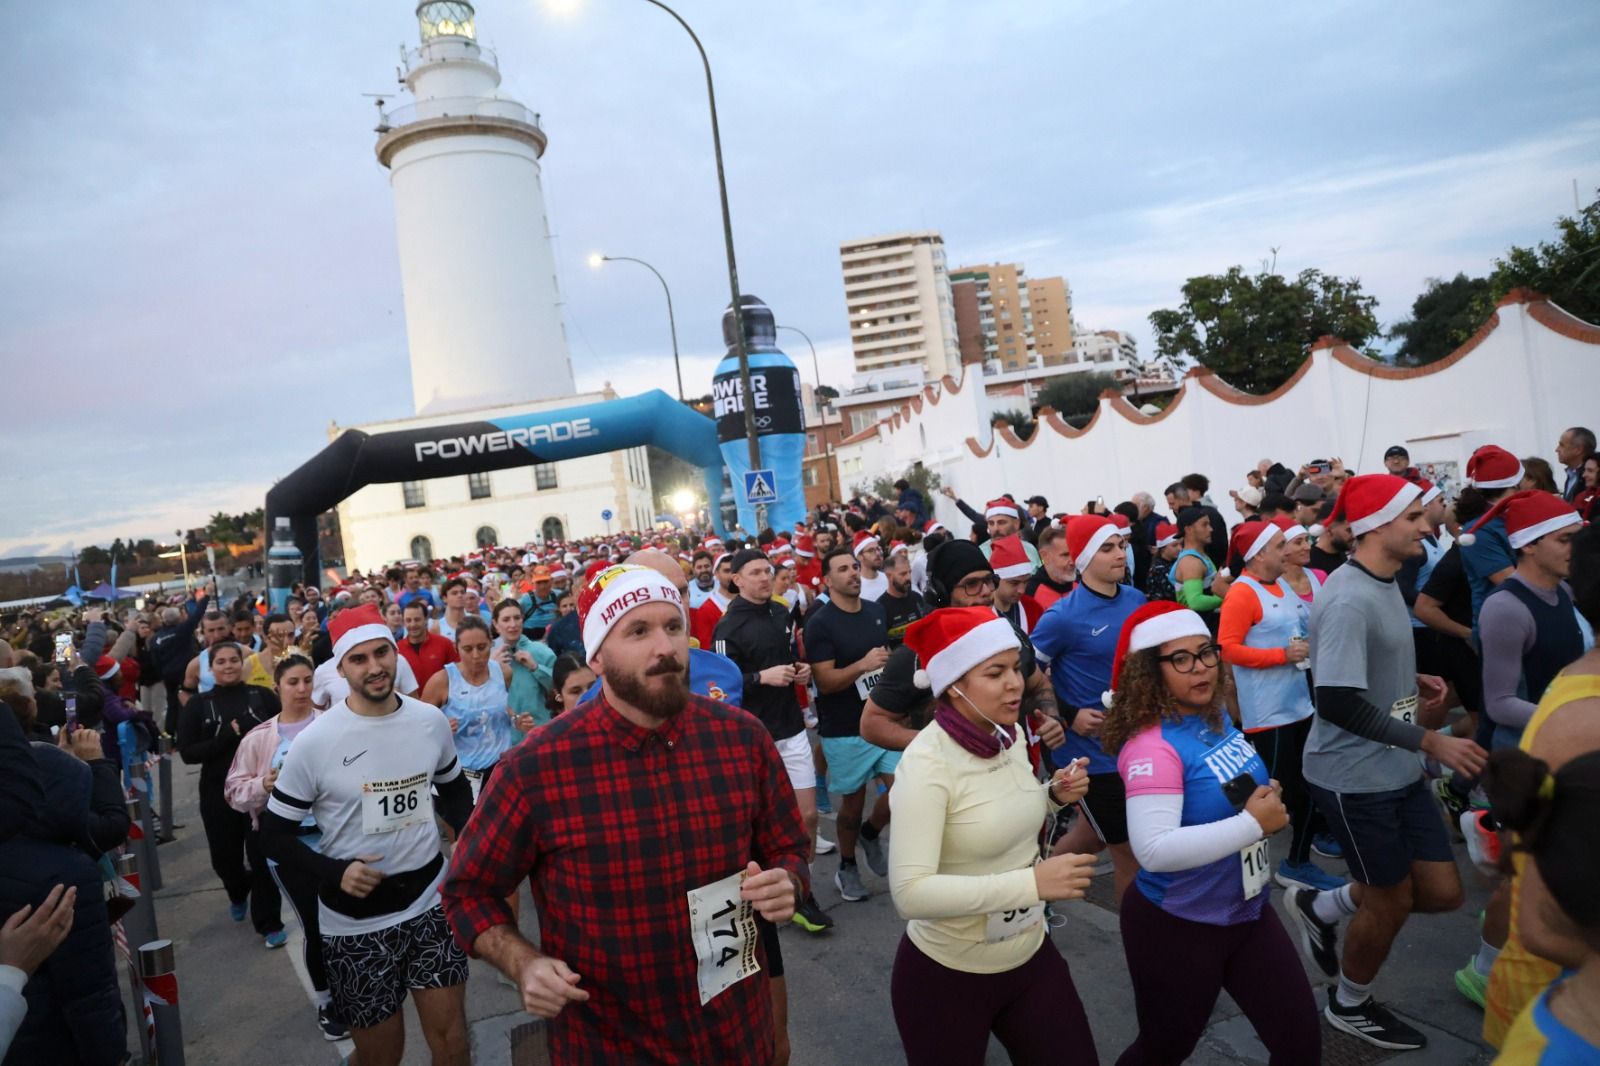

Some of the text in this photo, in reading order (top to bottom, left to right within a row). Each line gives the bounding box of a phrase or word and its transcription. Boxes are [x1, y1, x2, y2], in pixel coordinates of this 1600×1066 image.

[712, 374, 768, 401] OWER
[414, 417, 593, 462] POWERADE
[378, 789, 418, 817] 186
[711, 899, 739, 968] 174
[747, 920, 757, 971] SILVESTRE
